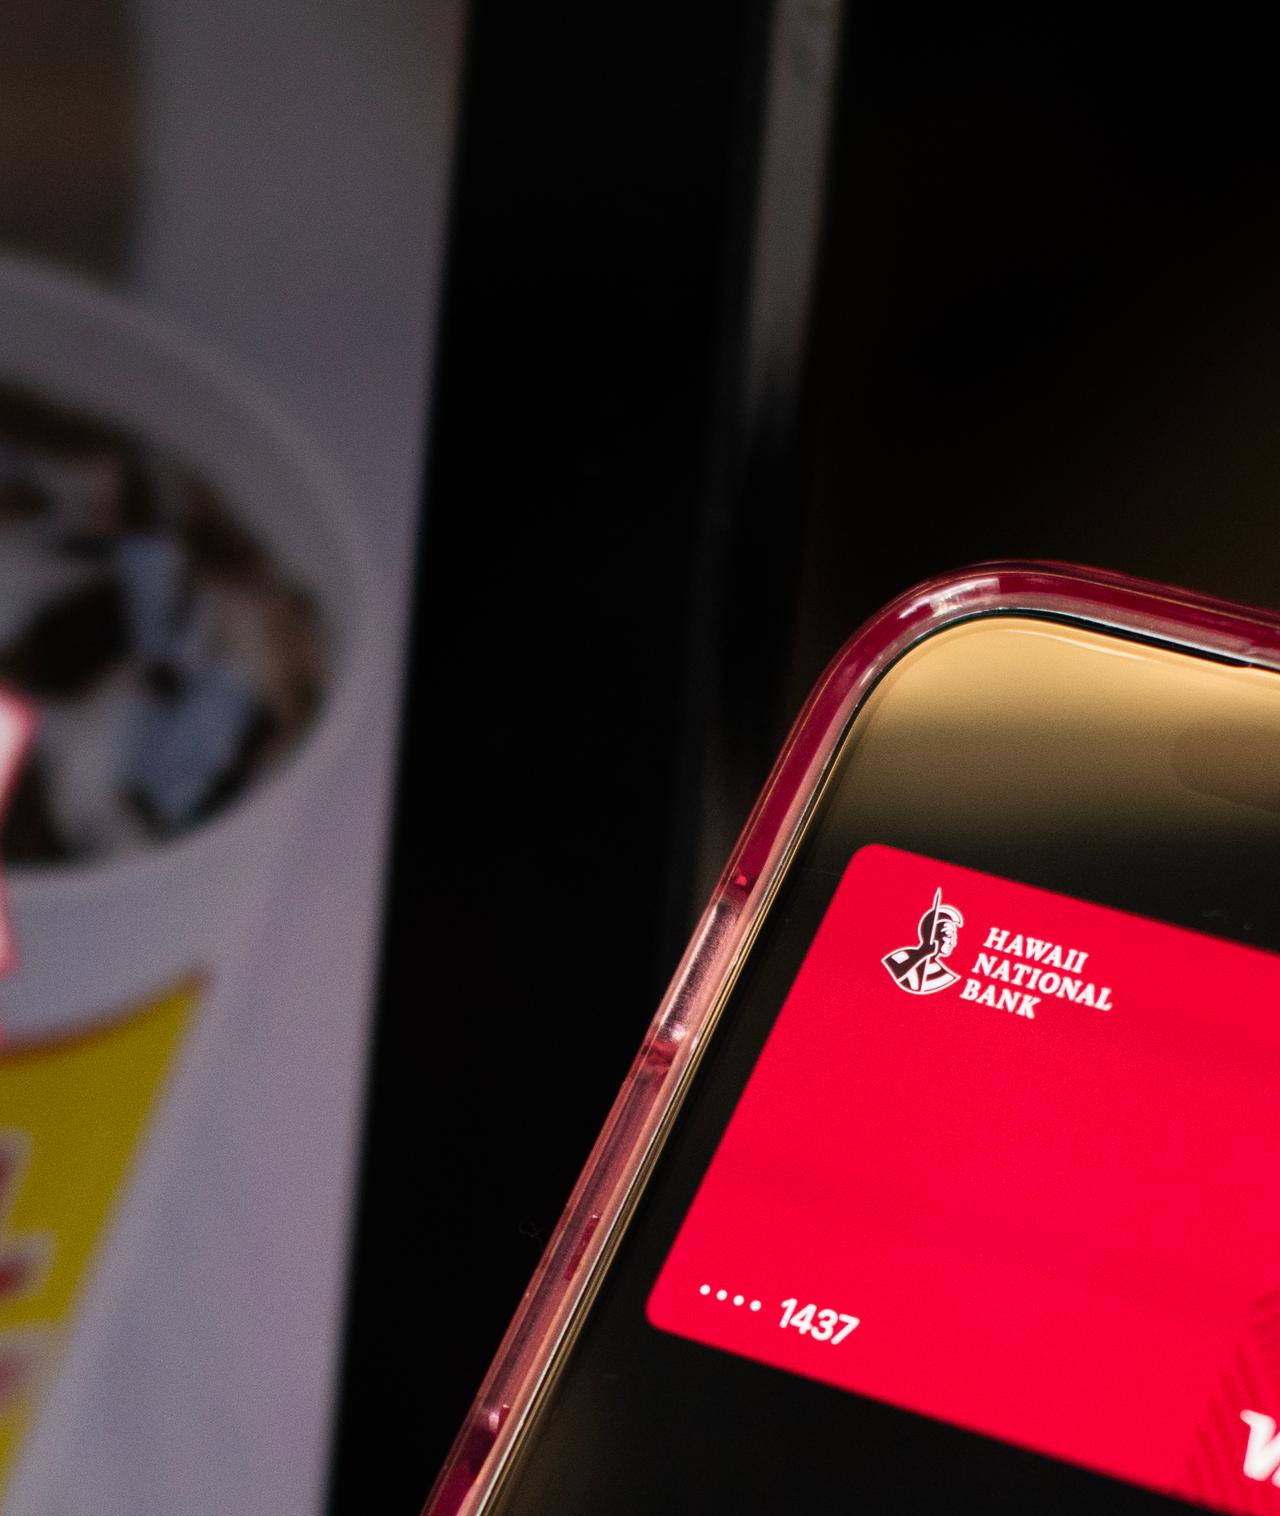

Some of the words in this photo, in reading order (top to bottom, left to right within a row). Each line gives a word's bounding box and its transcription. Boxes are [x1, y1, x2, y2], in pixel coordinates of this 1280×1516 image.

[983, 926, 1089, 974] HAWAII
[960, 978, 1042, 1020] BANK
[971, 952, 1113, 1012] NATIONAL
[779, 1297, 861, 1345] 1437
